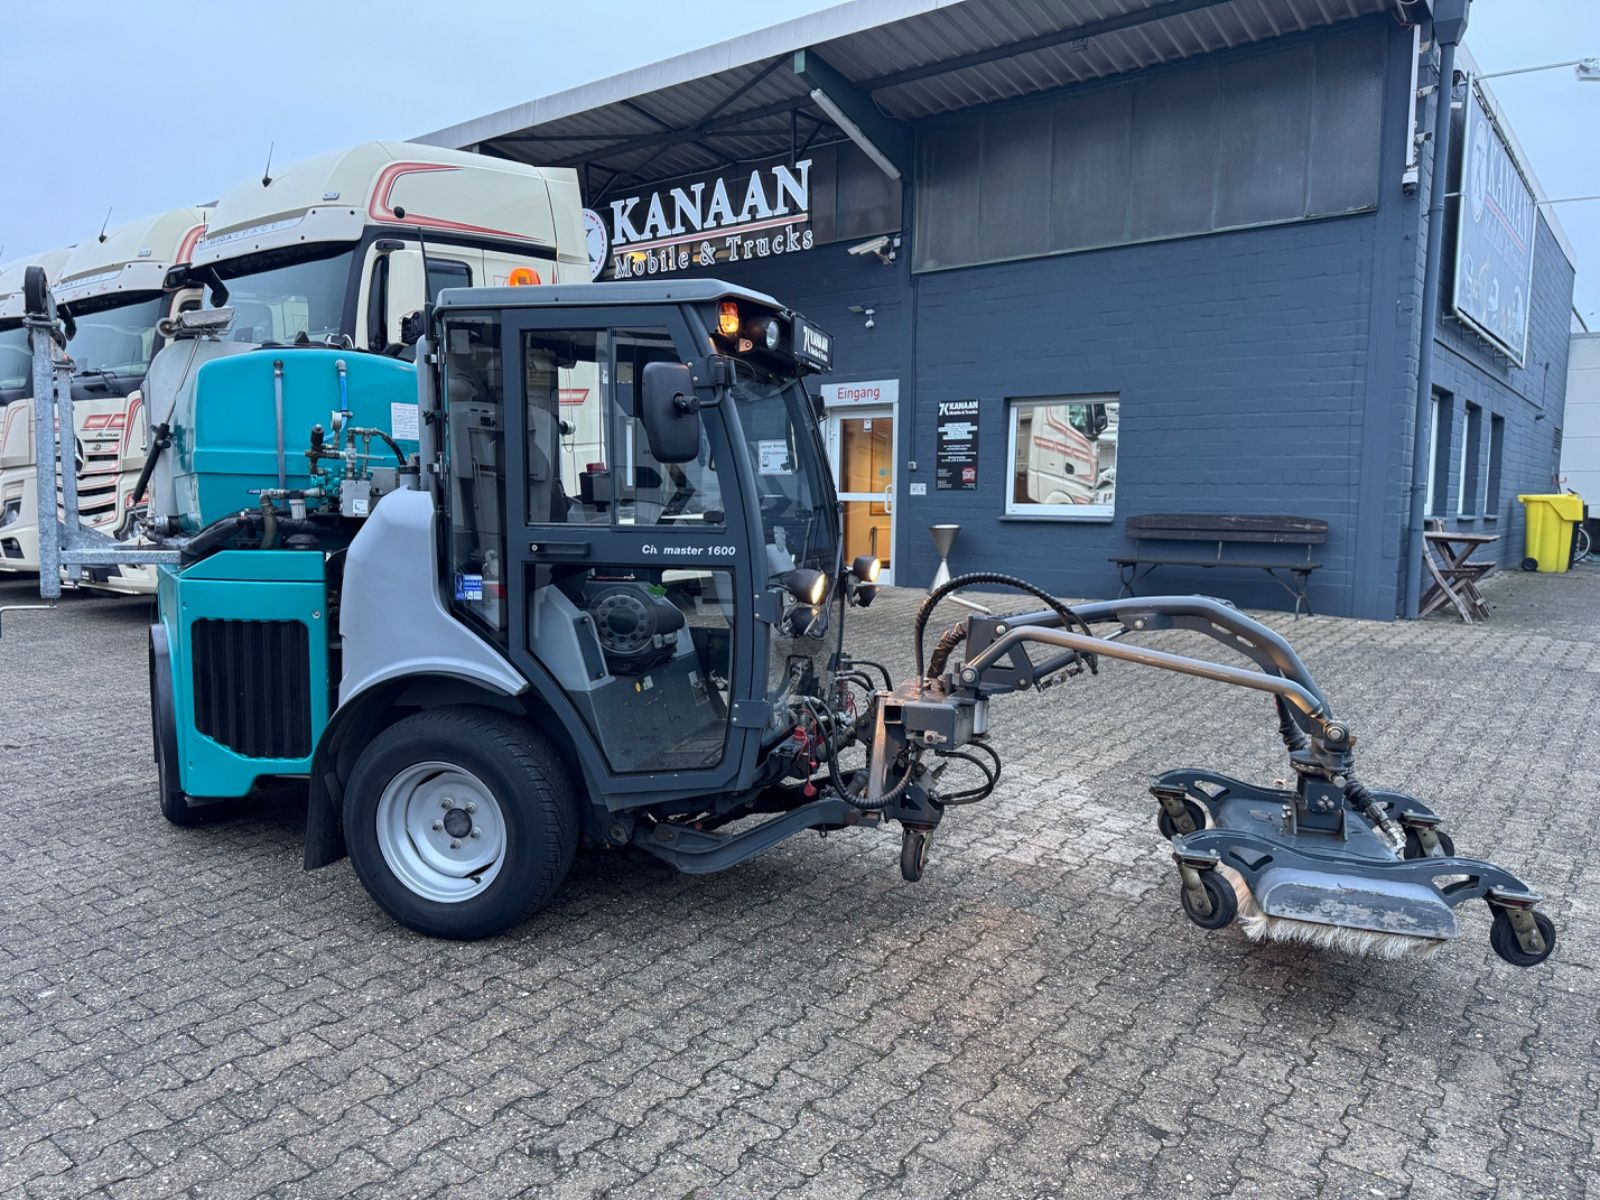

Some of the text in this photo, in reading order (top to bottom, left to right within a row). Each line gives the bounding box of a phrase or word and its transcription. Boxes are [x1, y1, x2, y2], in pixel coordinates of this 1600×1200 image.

[610, 158, 813, 246] KANAAN
[613, 245, 690, 279] Mobile
[698, 240, 717, 266] &
[725, 224, 814, 262] Trucks
[837, 387, 880, 401] Eingang
[949, 401, 978, 410] KANAAN
[663, 546, 704, 555] master
[708, 546, 736, 556] 1600
